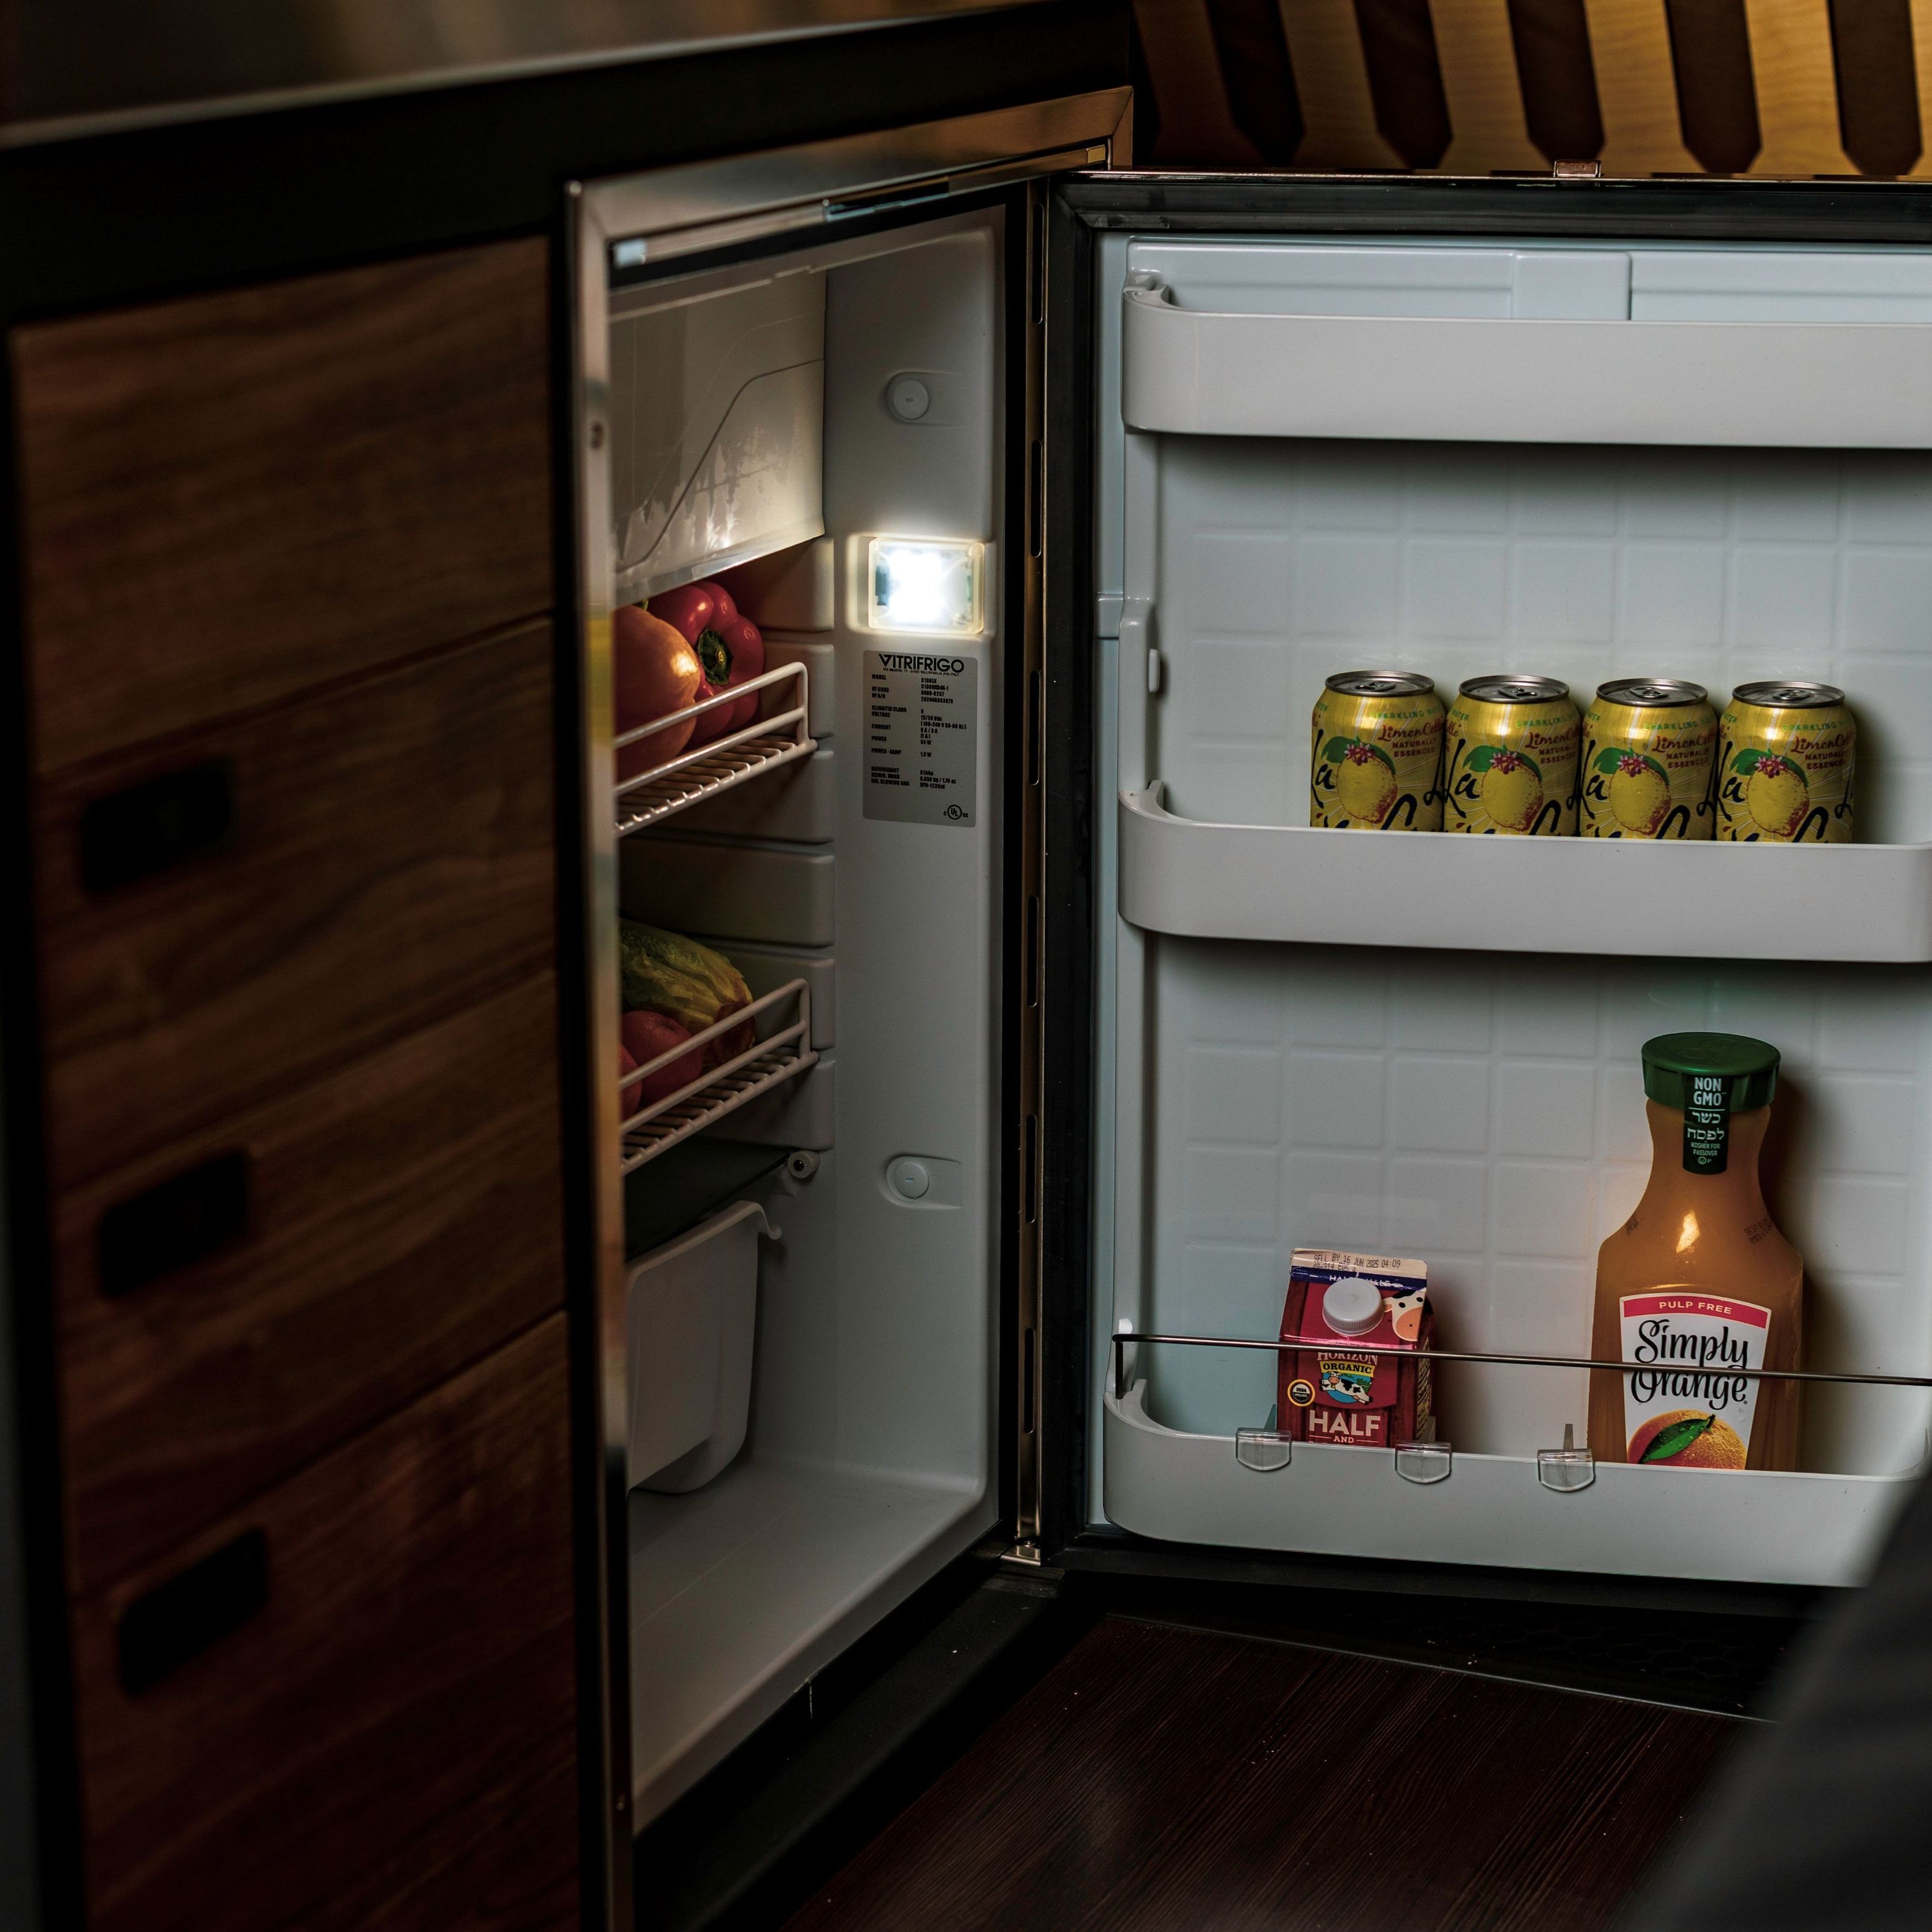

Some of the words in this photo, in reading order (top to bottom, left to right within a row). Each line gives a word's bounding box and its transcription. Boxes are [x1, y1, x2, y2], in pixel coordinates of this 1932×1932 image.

[878, 654, 964, 673] VITRIFRIGO
[1392, 738, 1436, 748] NATURALLY
[1394, 746, 1435, 757] ESSENCED
[1694, 1077, 1722, 1092] NON
[1692, 1112, 1721, 1124] כשר
[1687, 1128, 1725, 1141] לפסח
[1314, 1254, 1328, 1264] SELL
[1332, 1253, 1341, 1262] BY
[1343, 1255, 1350, 1264] 16
[1354, 1257, 1363, 1267] JUN
[1366, 1260, 1379, 1268] 2025
[1381, 1259, 1401, 1268] 04:09
[1658, 1301, 1694, 1309] PULP
[1698, 1302, 1732, 1314] FREE
[1634, 1319, 1748, 1368] Simply
[1317, 1351, 1378, 1365] HORIZON
[1323, 1363, 1372, 1374] ORGANIC
[1631, 1370, 1748, 1410] Orange
[1309, 1410, 1381, 1437] HALF
[1333, 1435, 1354, 1444] AND
